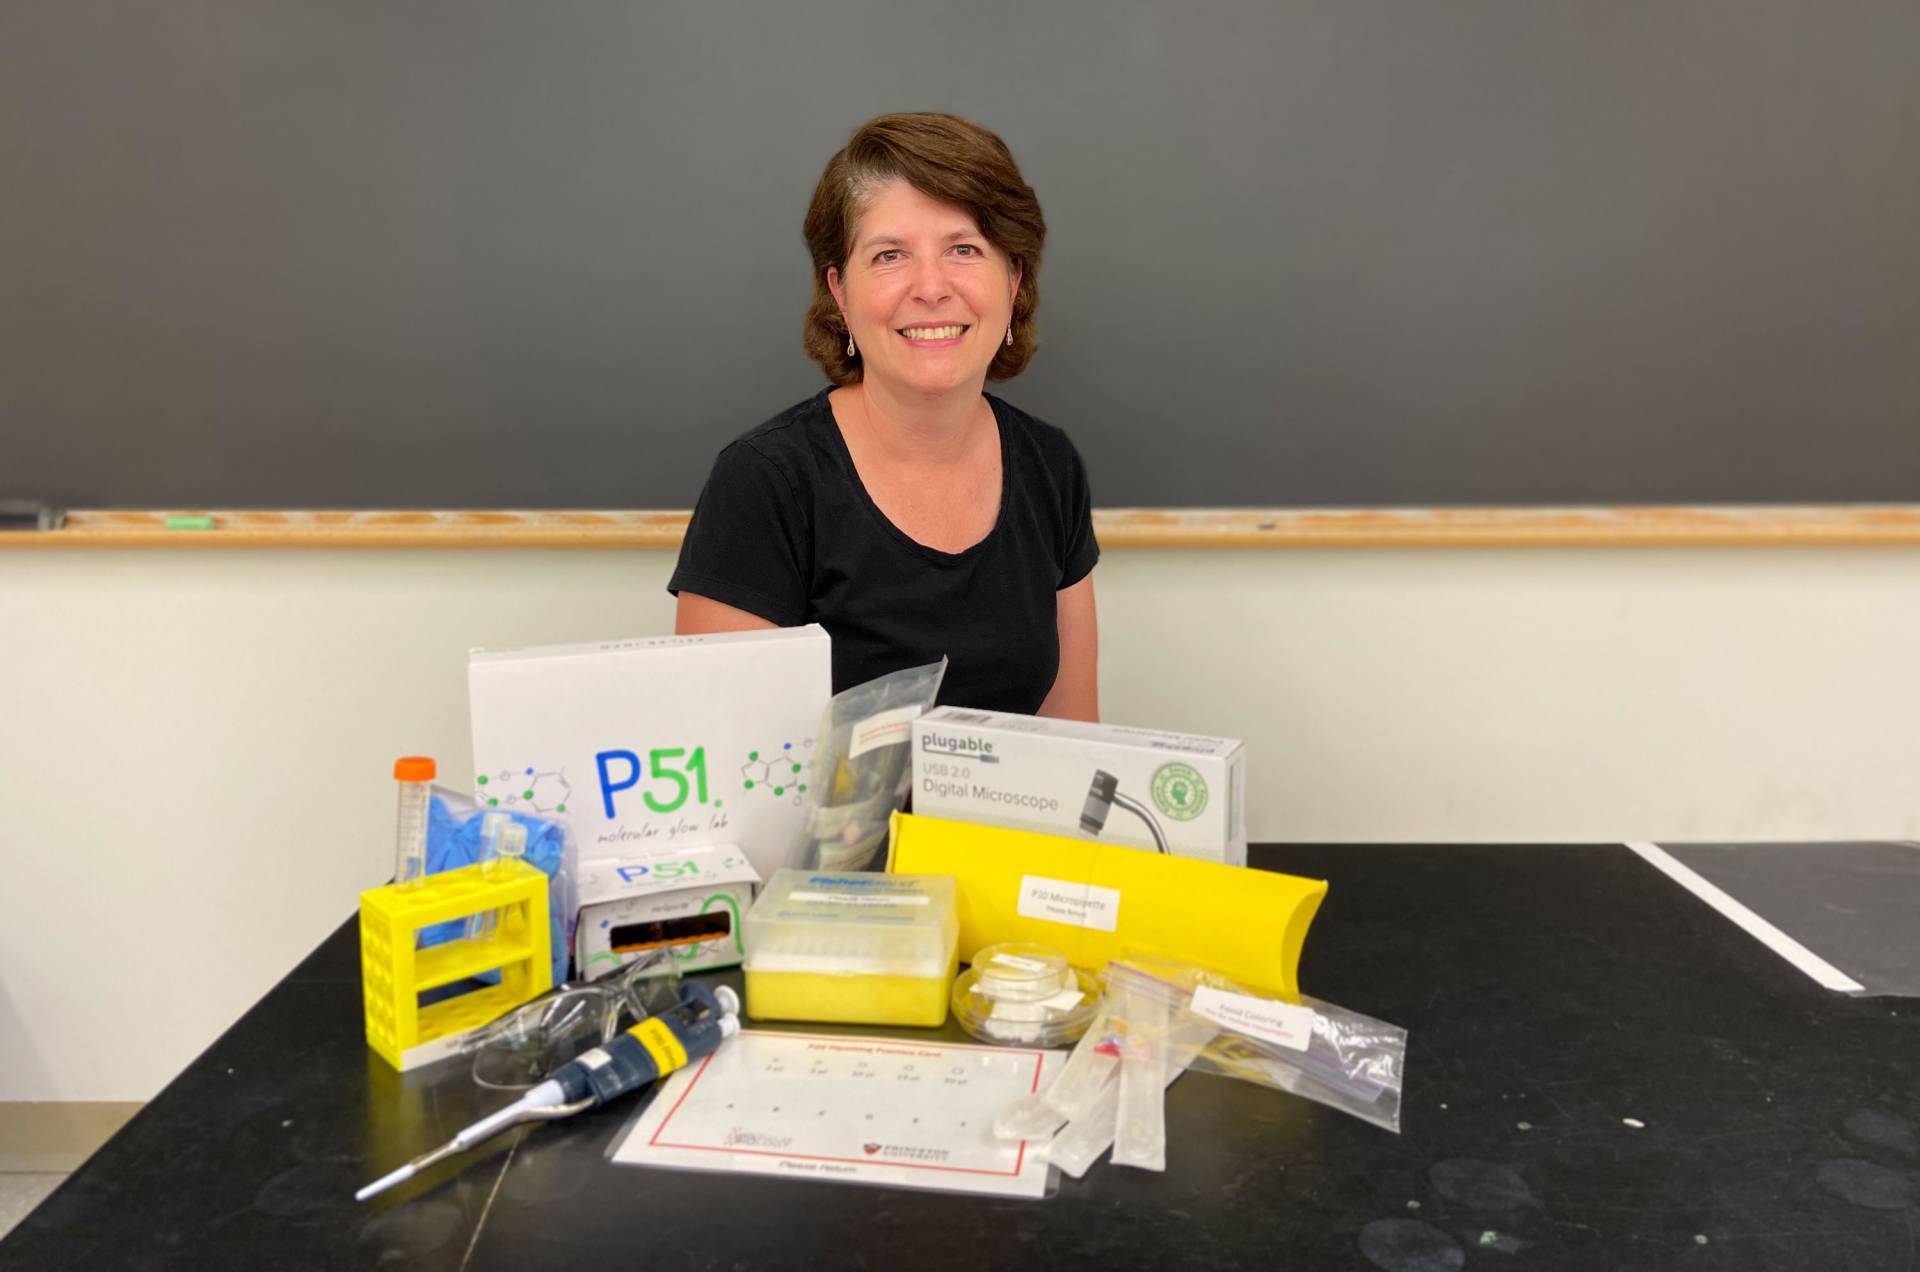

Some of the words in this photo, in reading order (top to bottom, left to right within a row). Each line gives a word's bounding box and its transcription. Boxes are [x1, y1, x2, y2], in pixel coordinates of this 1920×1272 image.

[922, 733, 993, 752] plugable
[923, 762, 948, 776] USB
[951, 766, 971, 779] 2.0
[923, 778, 968, 798] Digital
[972, 784, 1059, 812] Microscope
[597, 822, 659, 843] molecular
[669, 818, 699, 840] glow
[708, 812, 729, 831] lab
[1050, 892, 1106, 911] Micropipette
